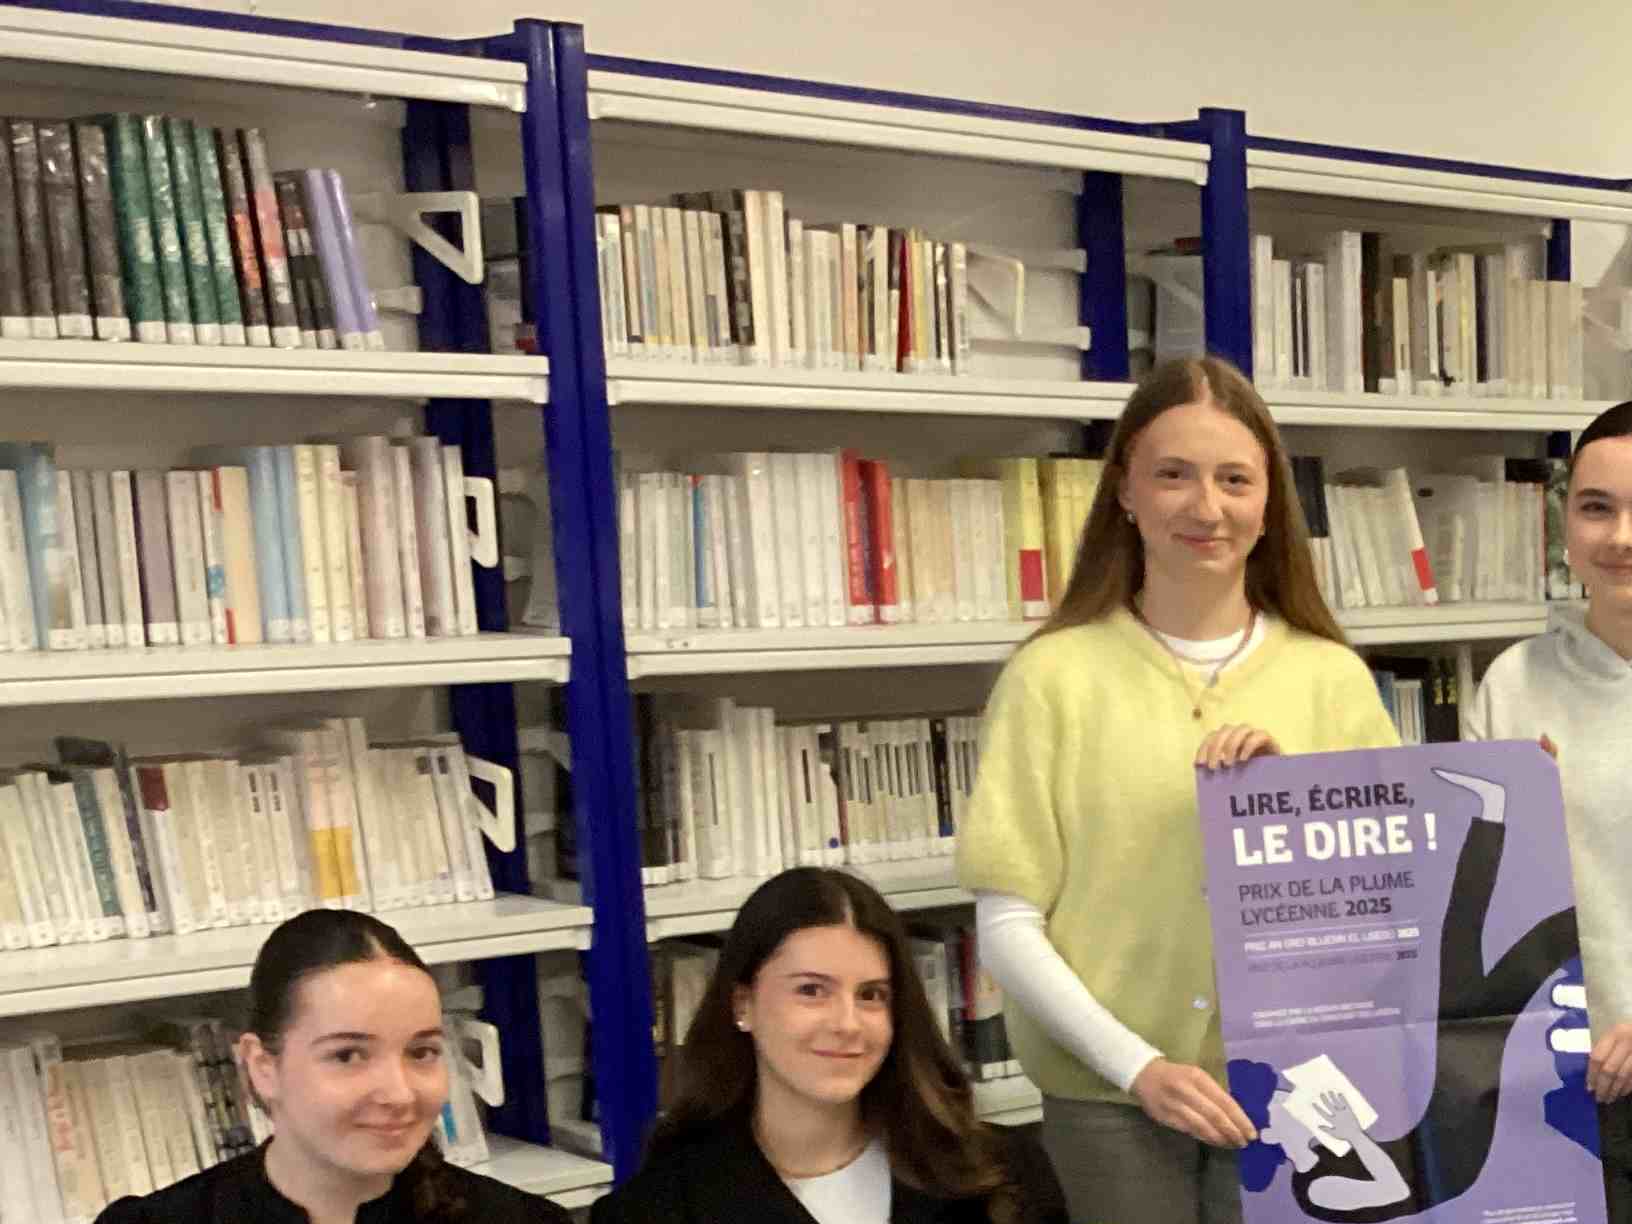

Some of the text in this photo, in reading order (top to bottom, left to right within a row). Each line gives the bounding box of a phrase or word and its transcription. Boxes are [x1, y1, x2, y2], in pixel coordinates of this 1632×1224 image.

[1229, 782, 1415, 817] LIRE, ÉCRIRE,
[1233, 824, 1293, 866] LE
[1304, 815, 1413, 860] DIRE
[1238, 871, 1415, 901] PRIX DE LA PLUME
[1240, 897, 1392, 926] LYCÉENNE 2025
